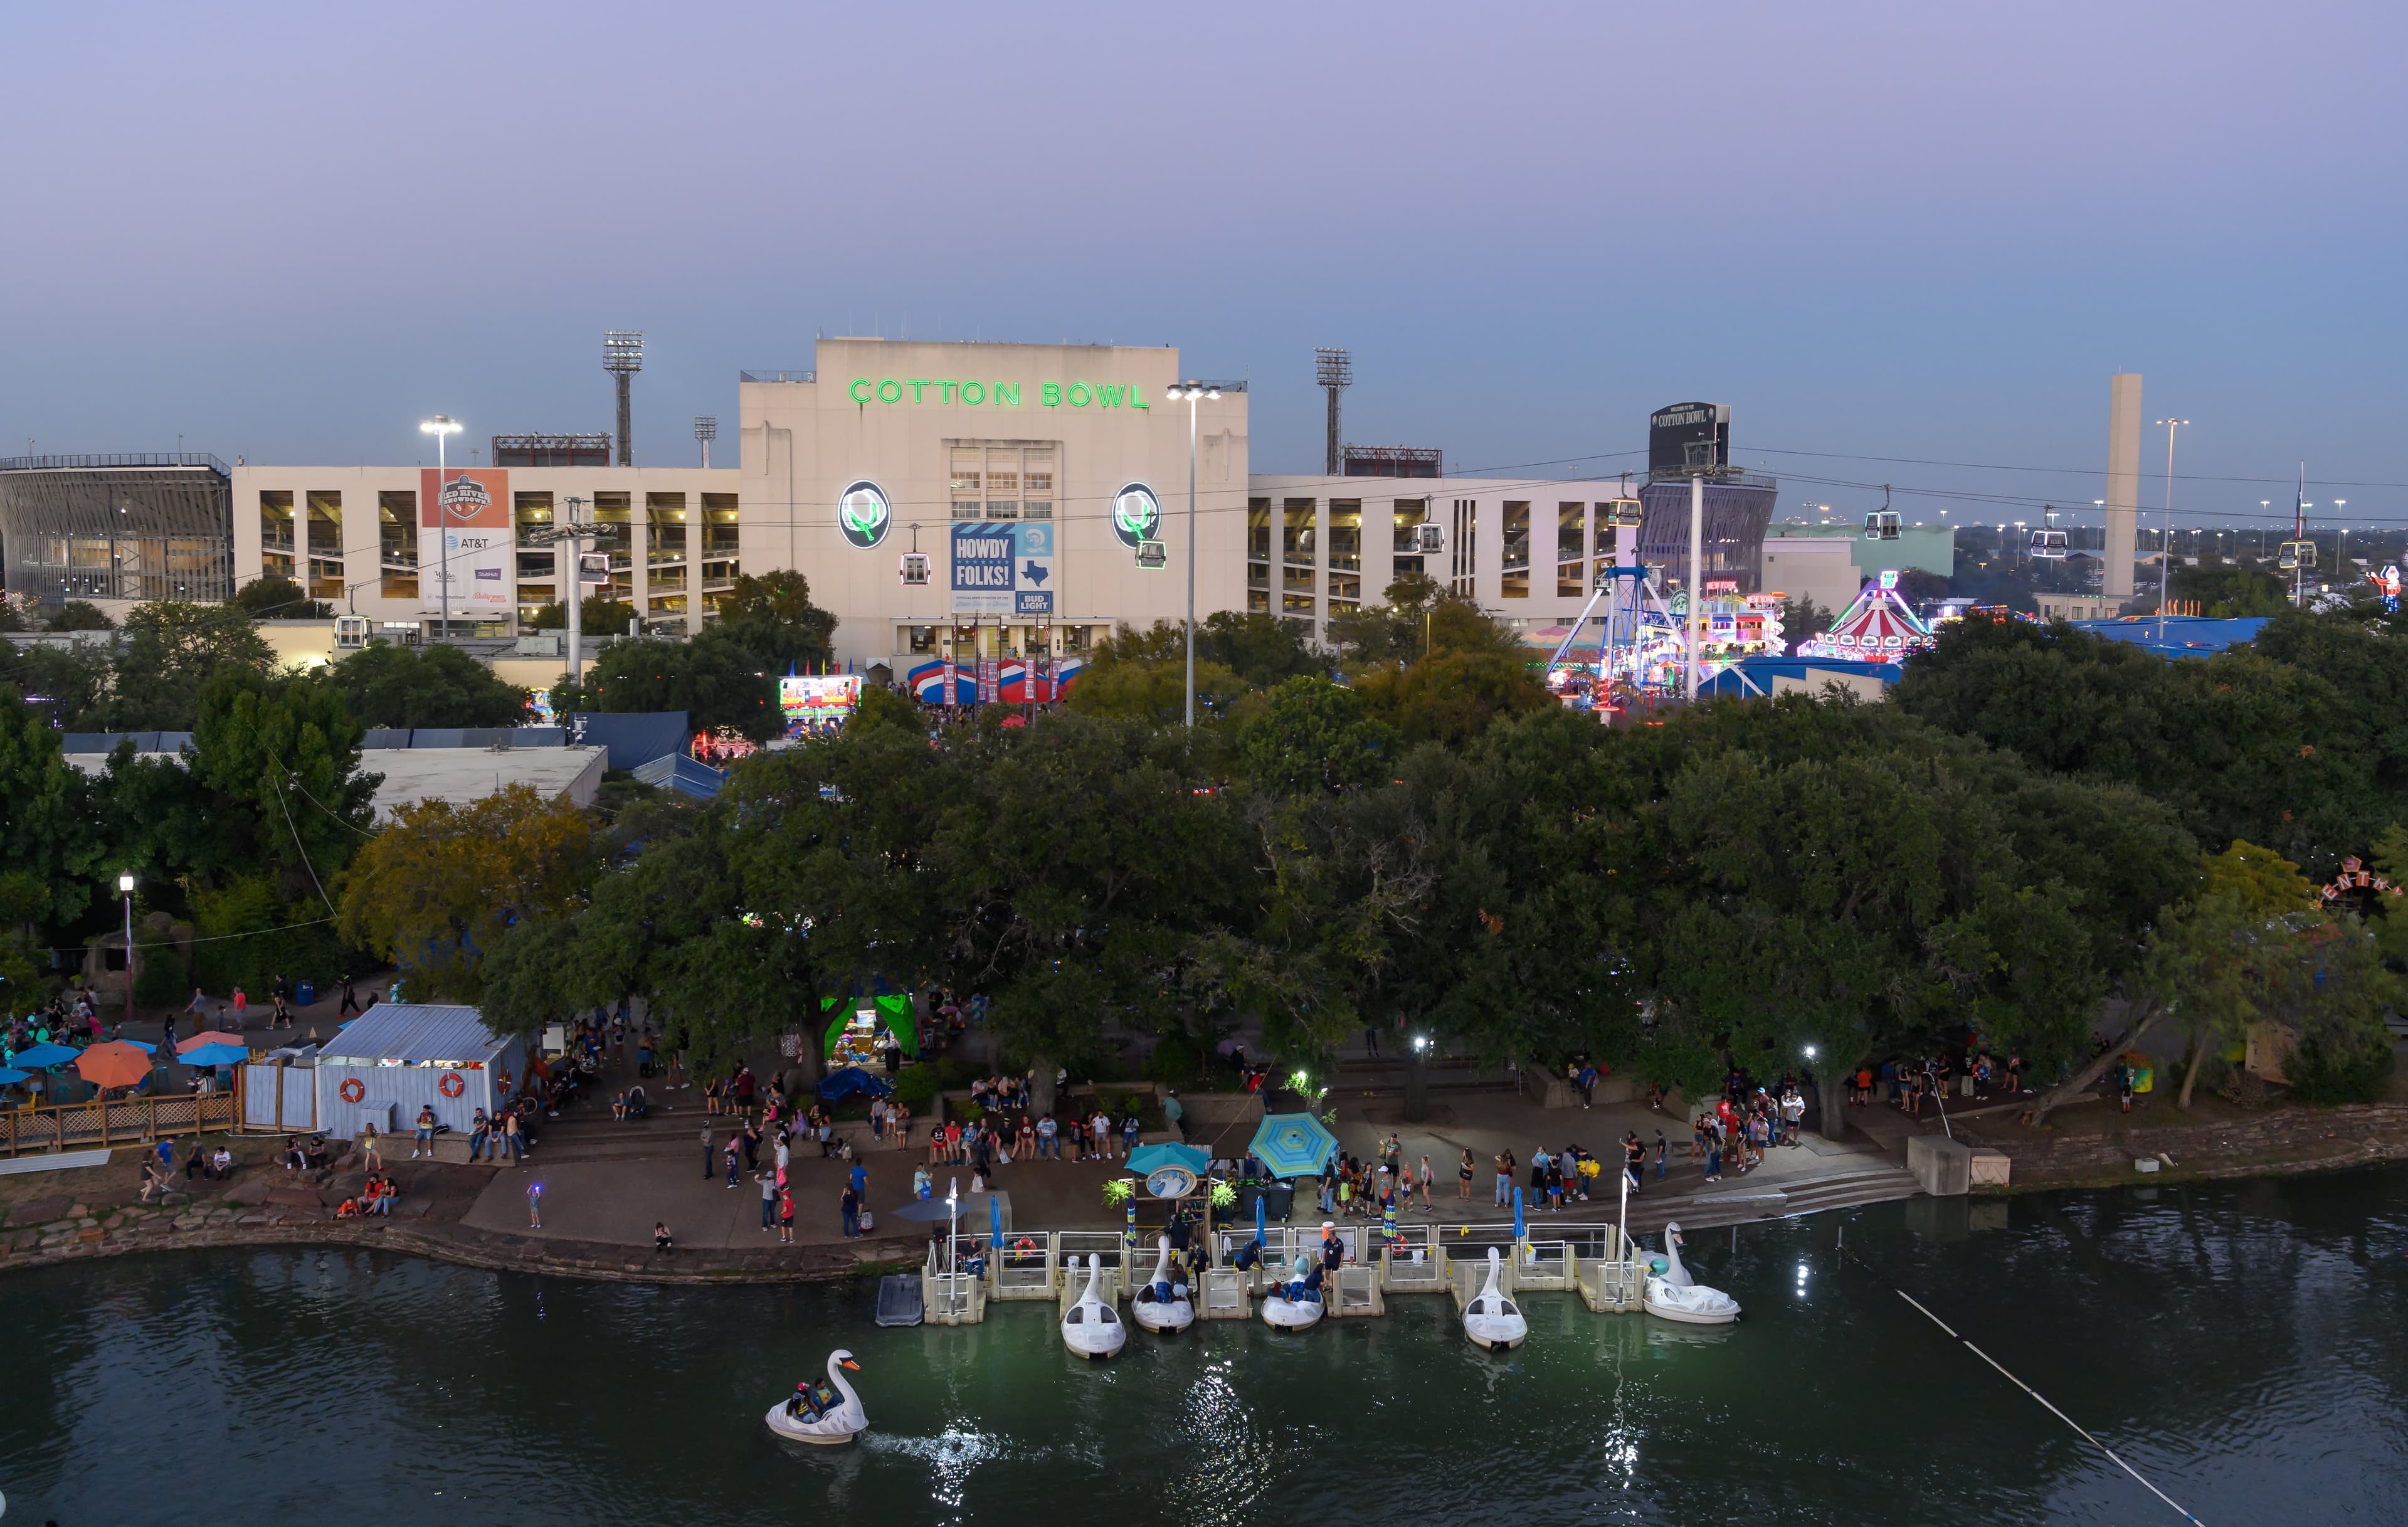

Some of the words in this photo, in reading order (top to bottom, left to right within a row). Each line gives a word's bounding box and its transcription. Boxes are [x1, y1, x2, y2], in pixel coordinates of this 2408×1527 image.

[850, 378, 1019, 405] COTTON
[1043, 382, 1149, 408] BOWL
[1659, 413, 1686, 427] COTTON
[1686, 410, 1706, 425] BOWL
[460, 490, 491, 503] RIVER
[461, 539, 488, 548] AT&T
[956, 539, 1009, 558] HOWDY
[956, 566, 1009, 586] FOLKS!
[1707, 581, 1720, 589] NEW
[1721, 581, 1737, 589] YORK
